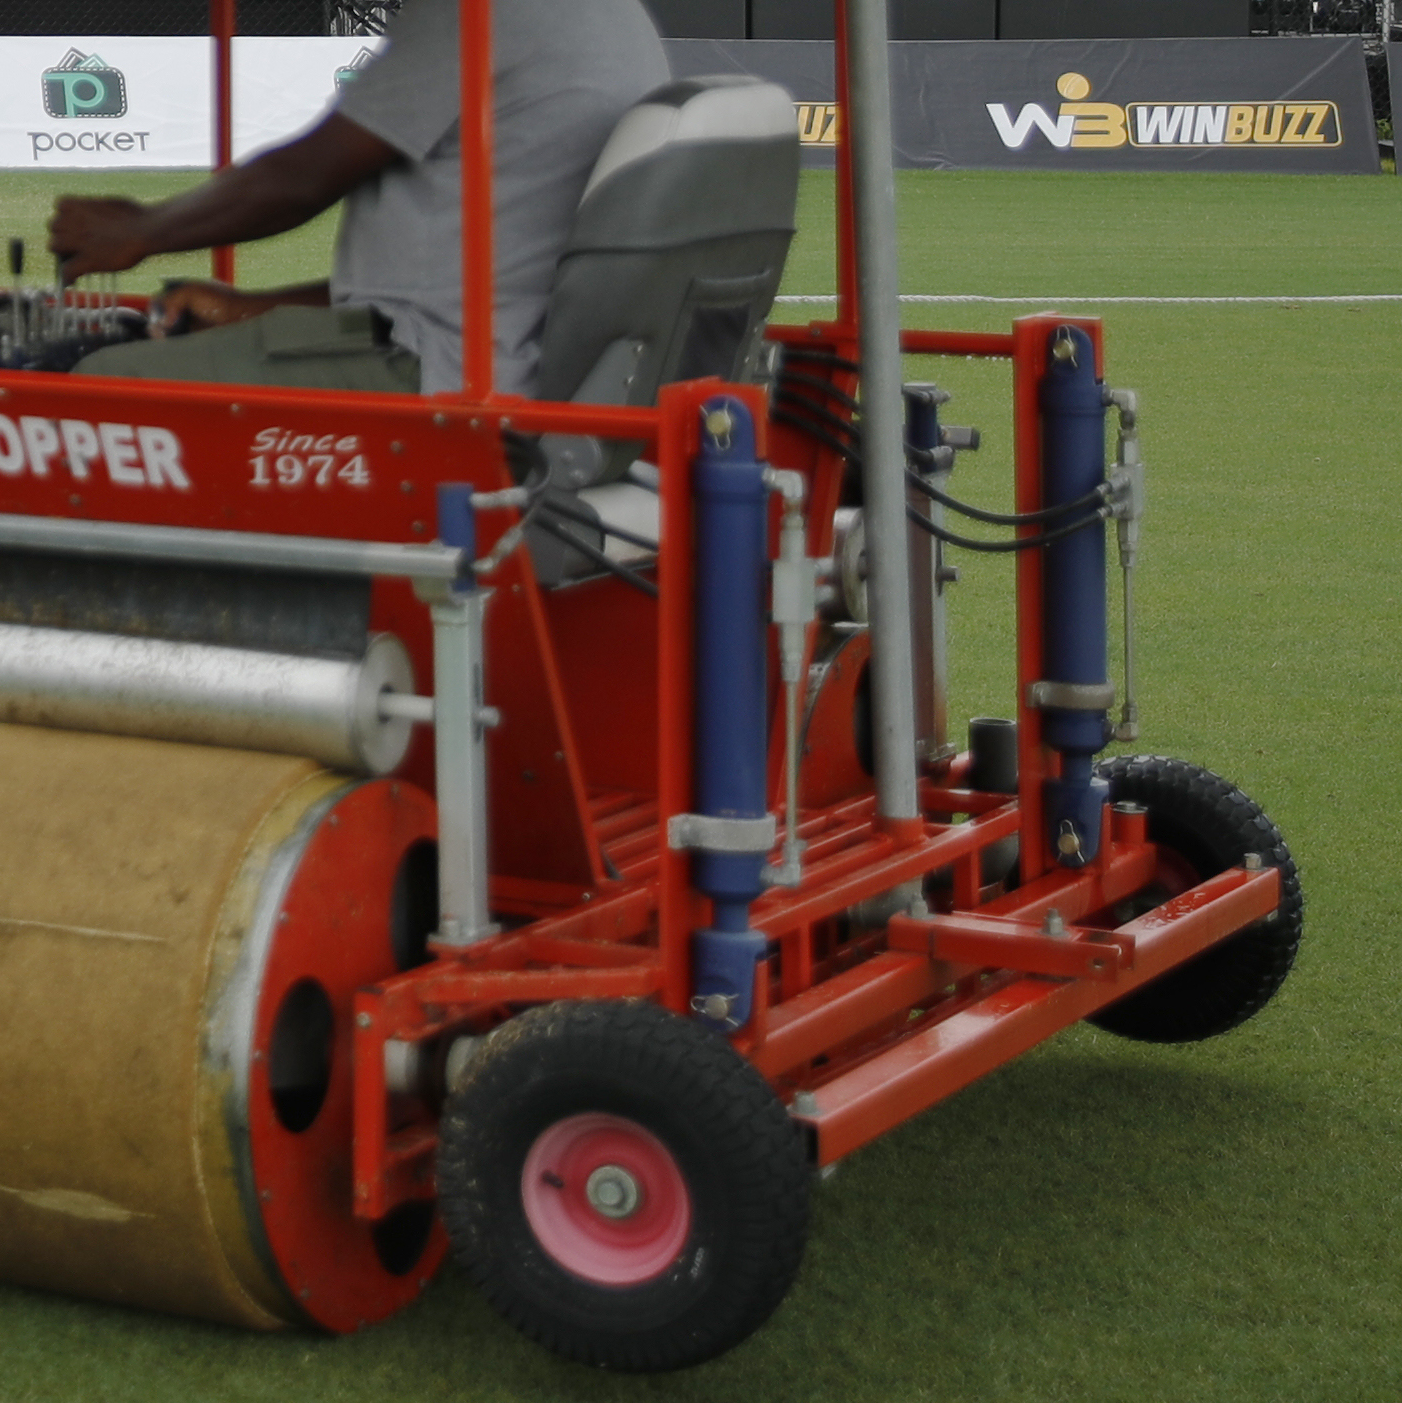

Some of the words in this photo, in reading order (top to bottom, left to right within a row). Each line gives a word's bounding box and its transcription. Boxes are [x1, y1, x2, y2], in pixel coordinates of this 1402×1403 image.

[1137, 104, 1330, 144] WINBUZZ
[249, 425, 359, 453] Since
[248, 453, 371, 487] 1974
